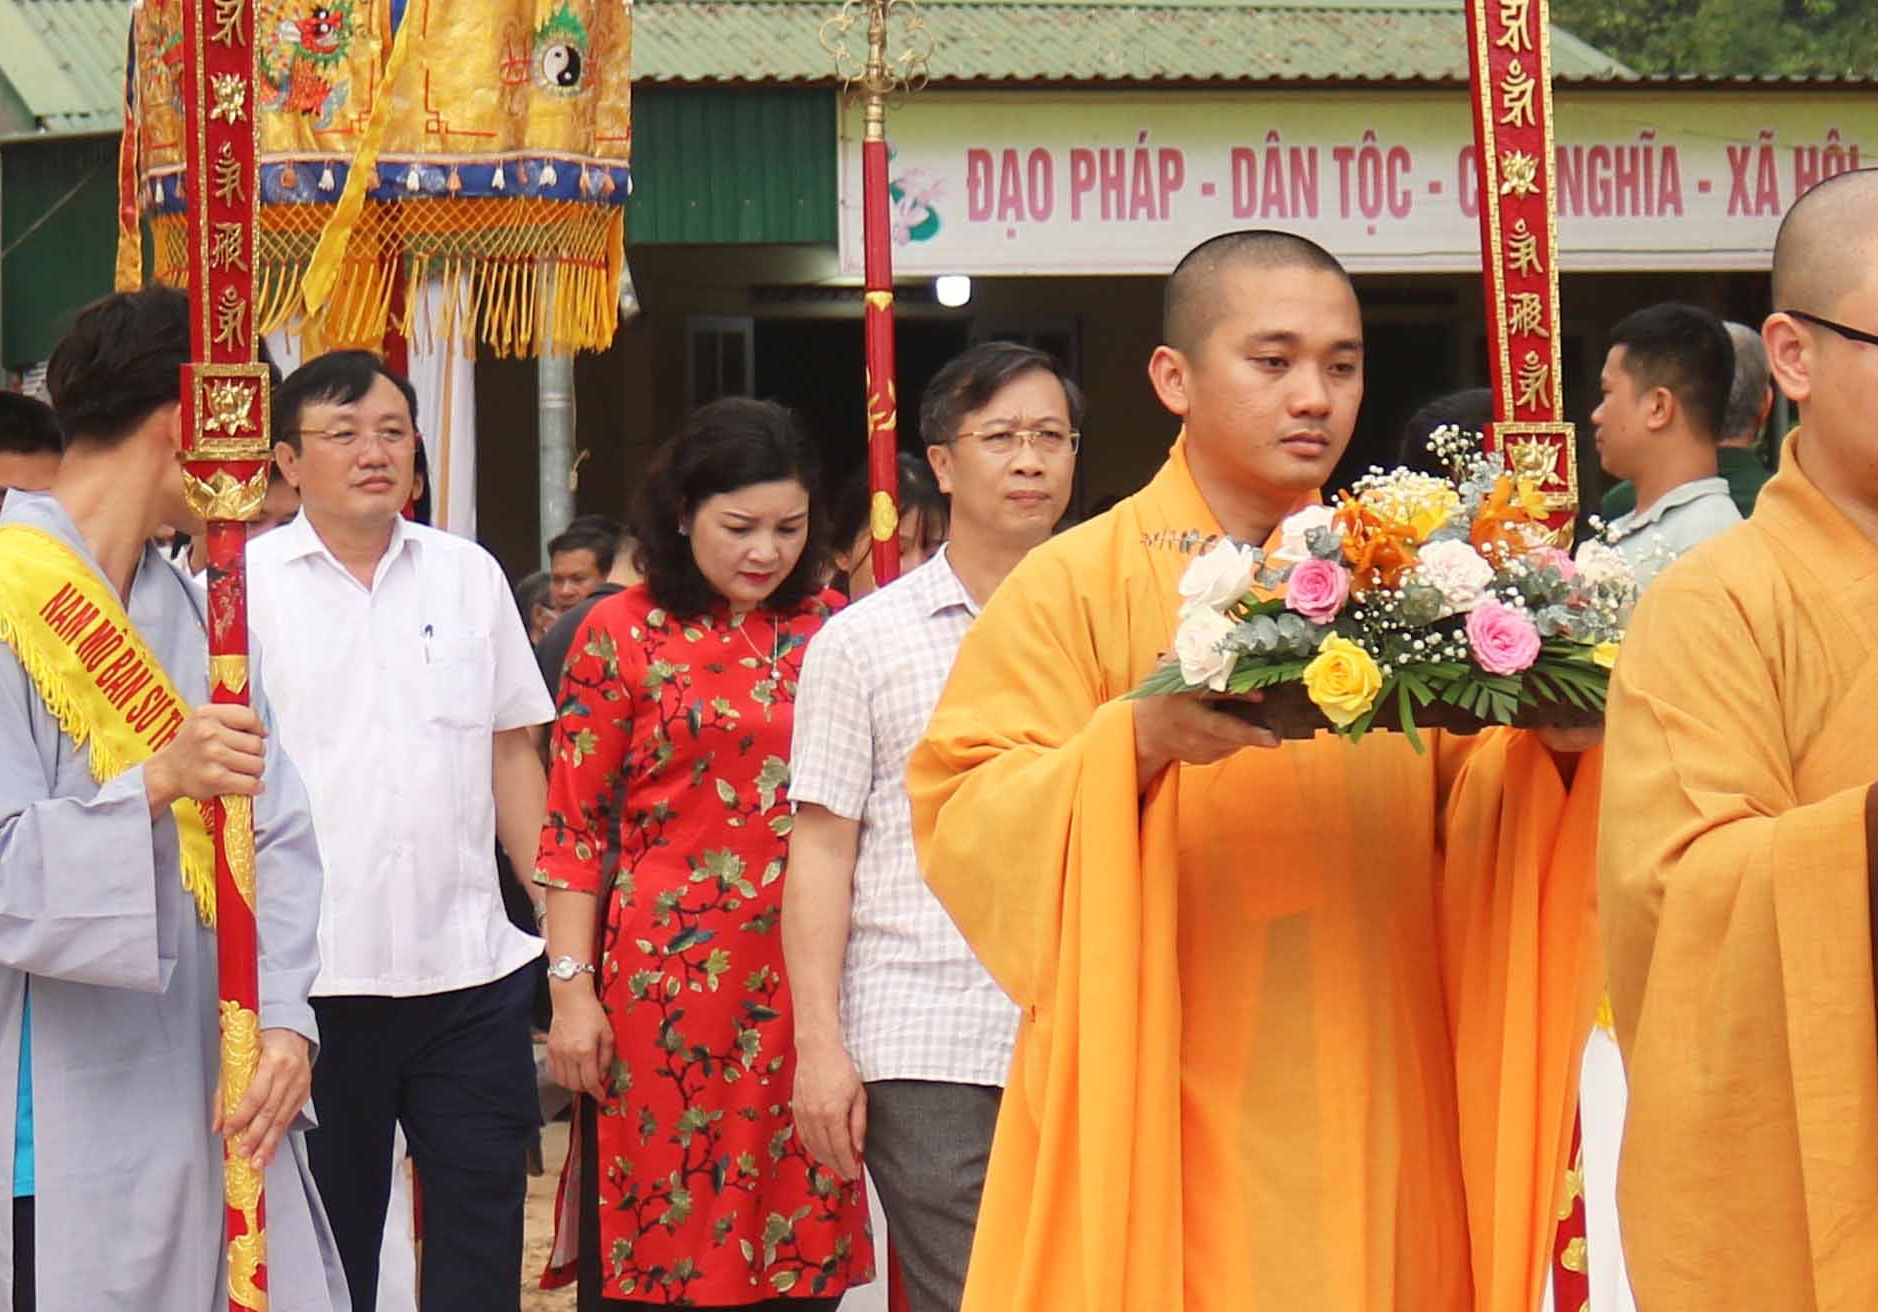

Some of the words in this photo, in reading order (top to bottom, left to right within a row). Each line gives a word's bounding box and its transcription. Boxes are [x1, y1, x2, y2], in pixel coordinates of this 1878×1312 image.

[966, 146, 1054, 237] ĐẠO
[1069, 129, 1185, 221] PHÁP
[1231, 130, 1320, 220] DÂN
[1332, 129, 1413, 235] TỘC
[1555, 129, 1684, 219] NGHĨA
[1726, 129, 1782, 217] XÃ
[39, 582, 101, 646] NAM
[75, 618, 128, 673] MÔ
